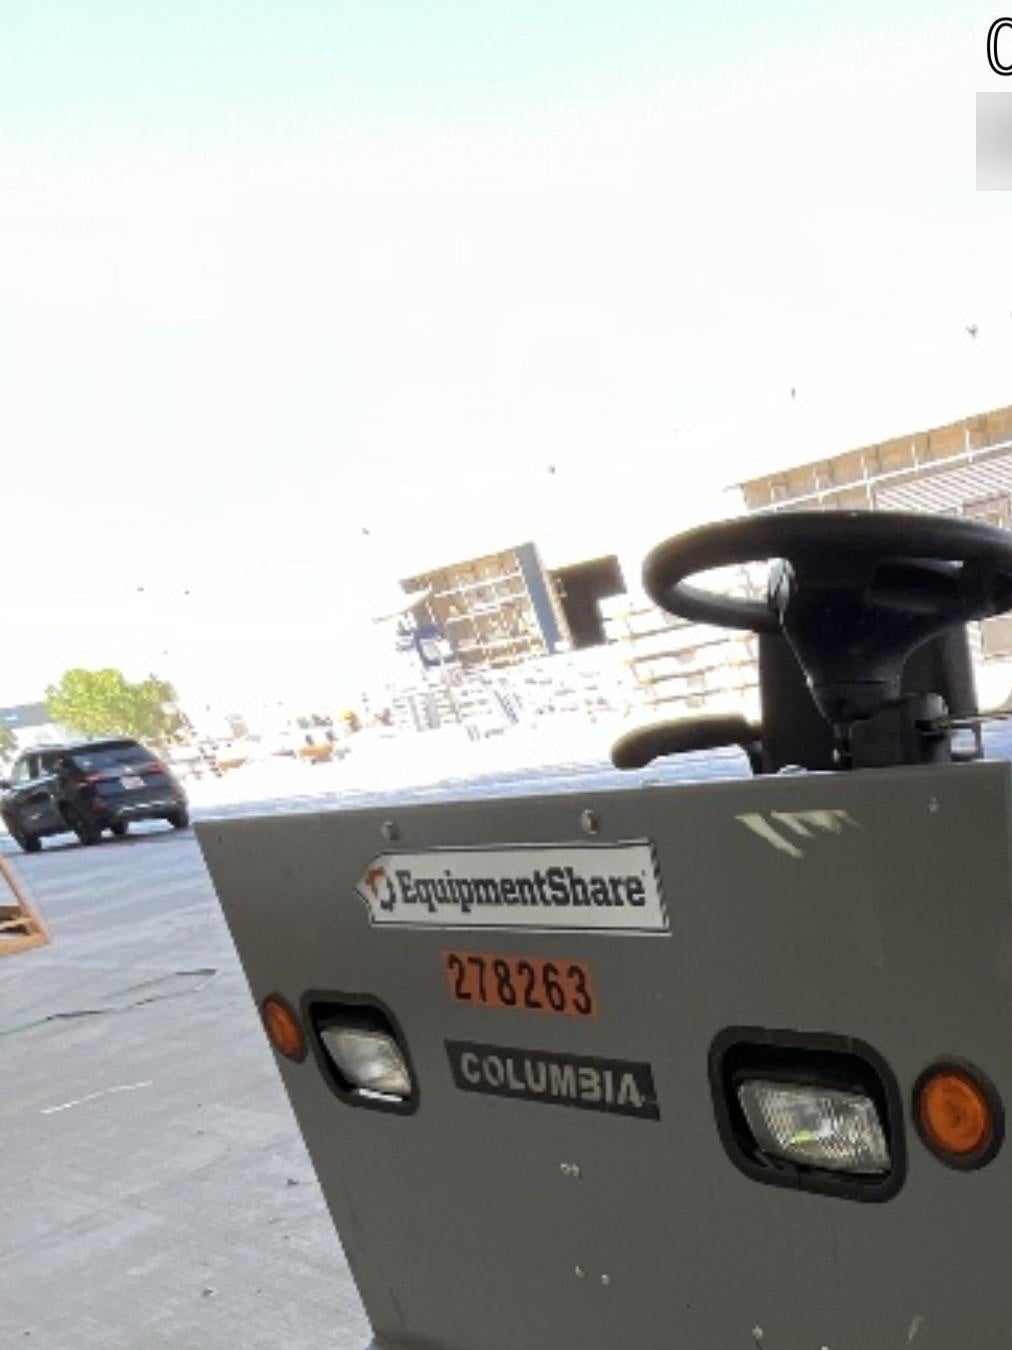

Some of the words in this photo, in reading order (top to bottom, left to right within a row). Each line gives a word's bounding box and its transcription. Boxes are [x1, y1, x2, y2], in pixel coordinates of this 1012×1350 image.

[395, 866, 647, 913] EquipmentShare
[448, 953, 592, 1015] 278263
[460, 1052, 643, 1108] COLUMBIA
